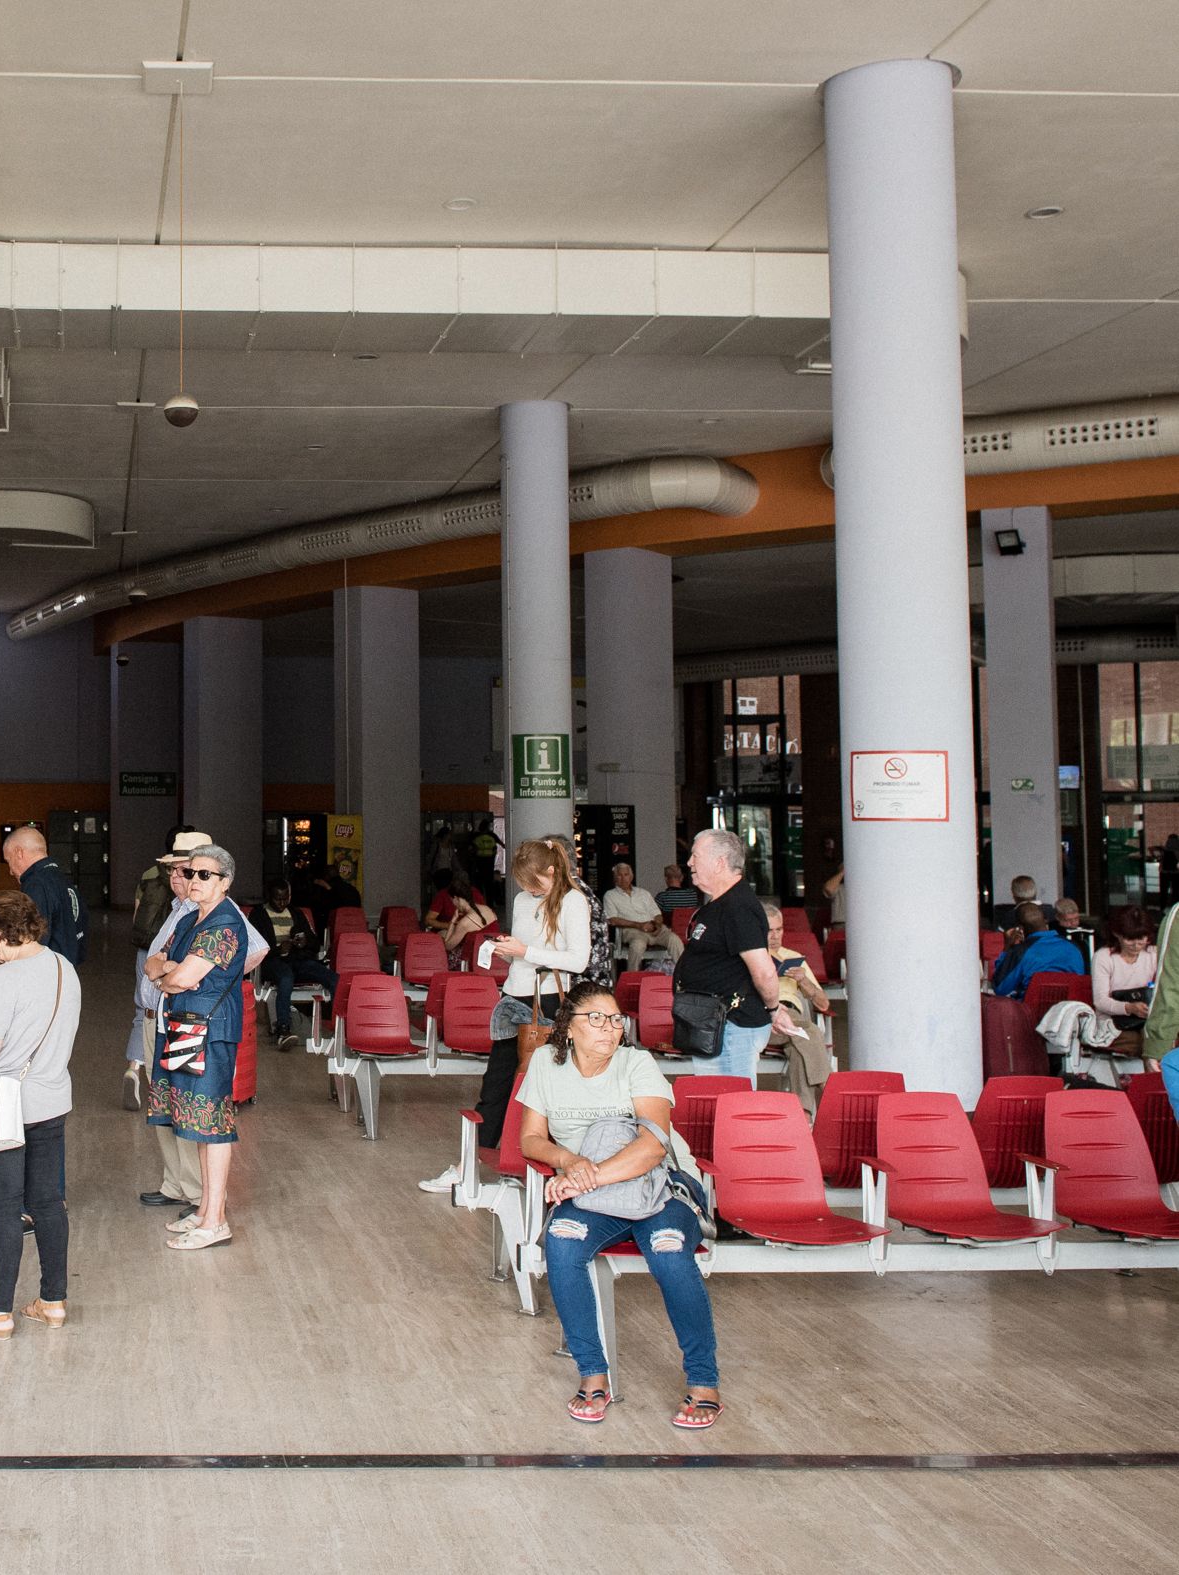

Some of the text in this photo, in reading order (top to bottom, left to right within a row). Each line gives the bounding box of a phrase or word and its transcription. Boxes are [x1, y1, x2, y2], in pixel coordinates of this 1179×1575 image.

[532, 777, 567, 787] Punto de
[519, 788, 567, 797] Información
